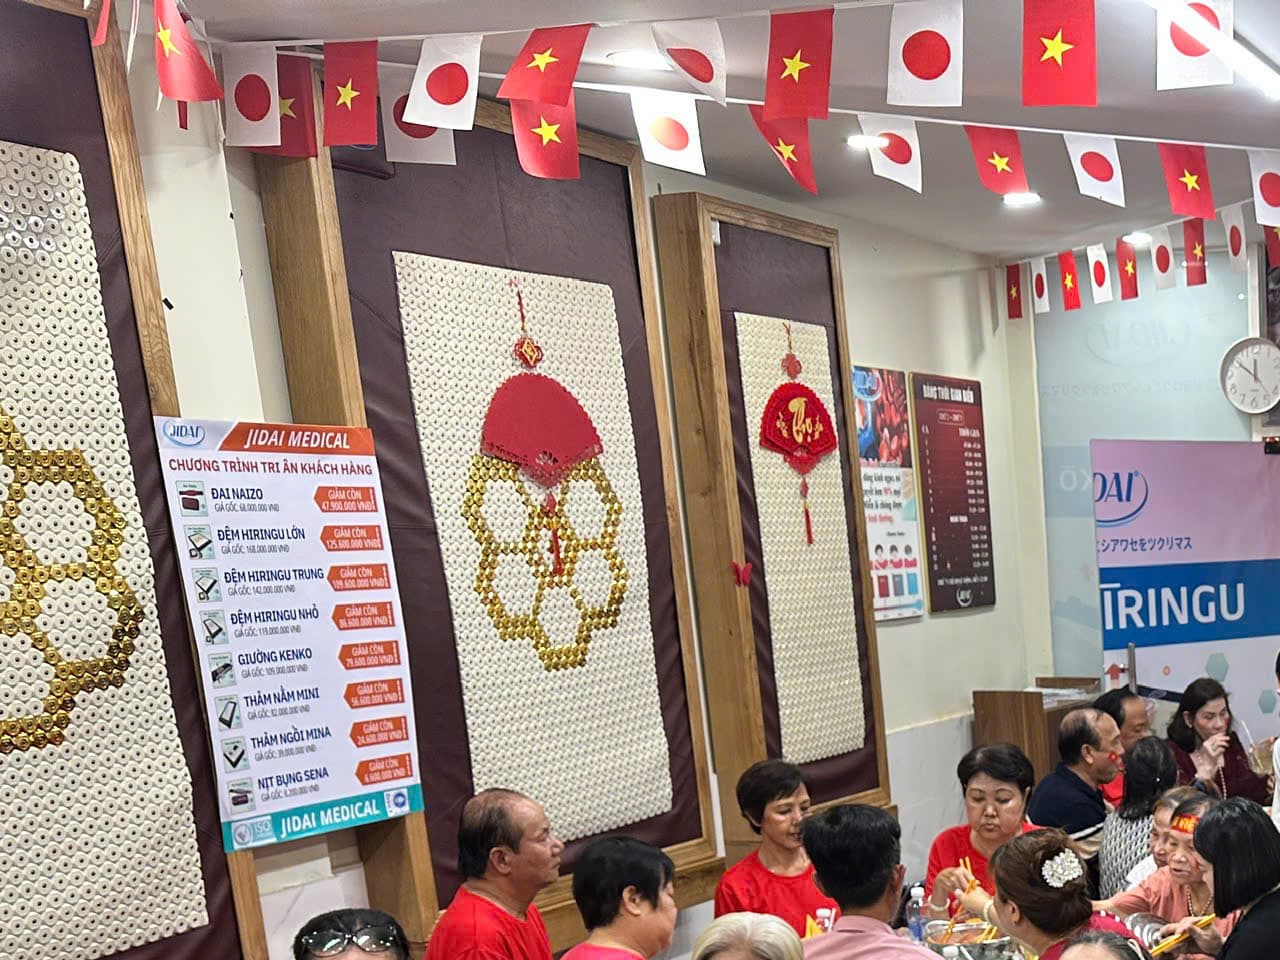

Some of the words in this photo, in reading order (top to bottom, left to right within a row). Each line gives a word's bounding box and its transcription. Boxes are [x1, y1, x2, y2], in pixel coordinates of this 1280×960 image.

[169, 424, 200, 438] JIDAI
[244, 428, 284, 449] JIDAI
[288, 430, 350, 449] MEDICAL
[169, 457, 220, 472] CHƯƠNG
[222, 457, 259, 473] TRÌNH
[261, 461, 281, 474] TRI
[283, 458, 299, 474] ÂN
[301, 459, 339, 475] KHÁCH
[341, 461, 373, 476] HÀNG
[211, 487, 230, 500] ĐAI
[232, 487, 264, 500] NAIZO
[217, 525, 240, 544] ĐỆM
[241, 528, 285, 541] HIRINGU
[287, 525, 306, 540] LỚN
[224, 567, 247, 584] ĐỆM
[248, 569, 292, 583] HIRINGU
[292, 567, 325, 580] TRUNG
[230, 608, 253, 625] ĐỆM
[253, 609, 297, 623] HIRINGU
[298, 602, 319, 620] NHỎ
[238, 648, 278, 666] GIƯỜNG
[279, 647, 313, 662] KENKO
[243, 690, 272, 707] THẢM
[273, 684, 296, 704] NẰM
[296, 687, 320, 701] MINI
[250, 731, 279, 749] THẢM
[279, 724, 305, 745] NGỒI
[305, 726, 332, 741] MINA
[257, 776, 274, 790] NỊT
[275, 771, 303, 787] BỤNG
[303, 766, 330, 781] SENA
[280, 814, 316, 839] JIDAI
[319, 799, 380, 826] MEDICAL
